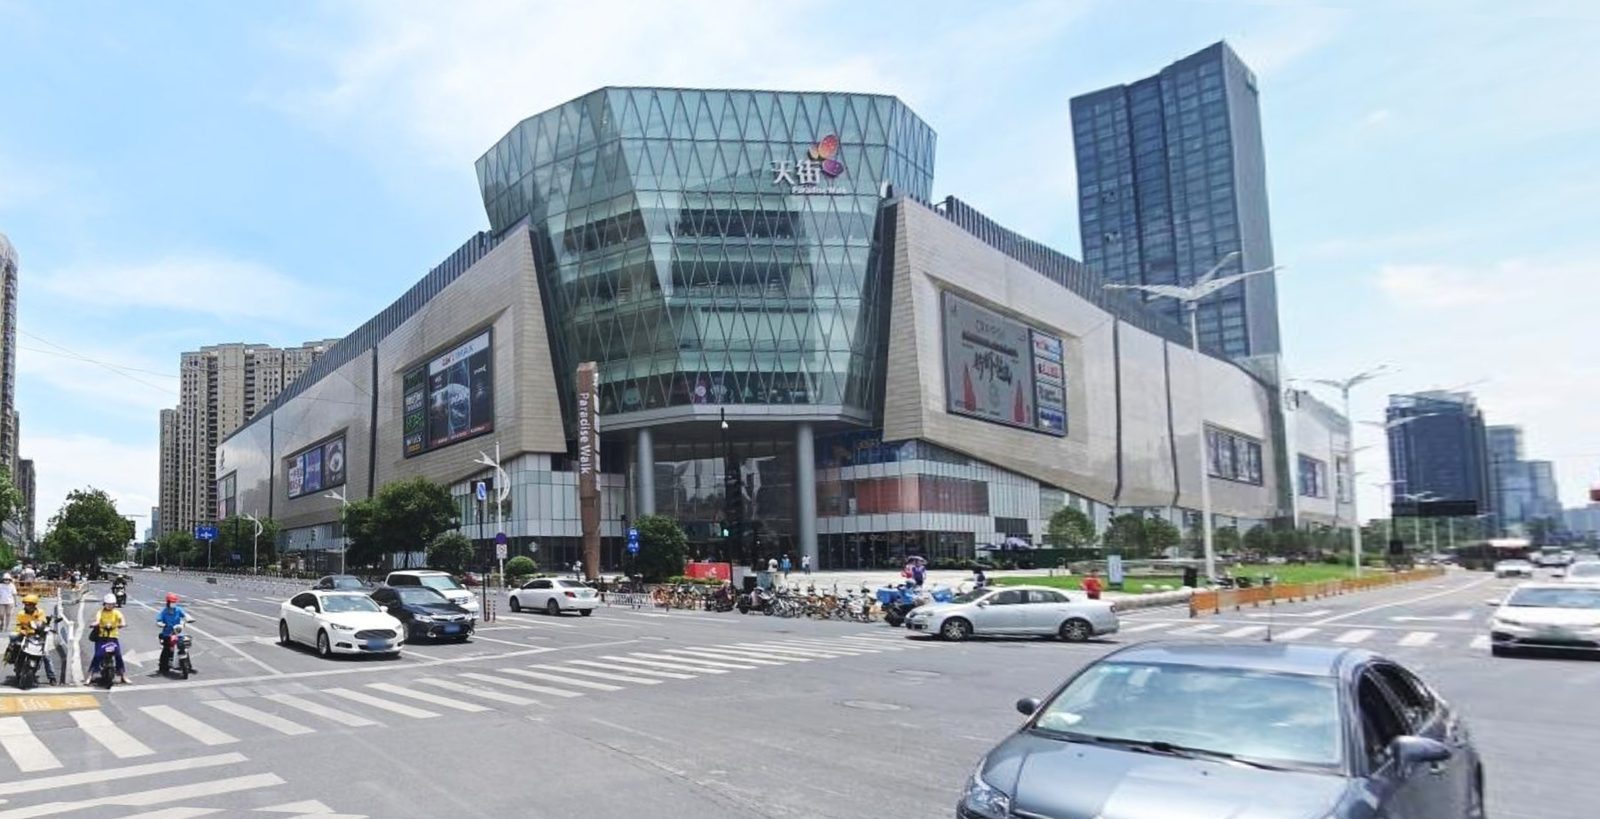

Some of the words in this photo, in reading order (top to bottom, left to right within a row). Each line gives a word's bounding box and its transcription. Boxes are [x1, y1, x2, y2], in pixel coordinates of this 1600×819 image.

[770, 160, 820, 185] 天街
[579, 392, 590, 443] Paradise
[580, 445, 592, 474] Walk
